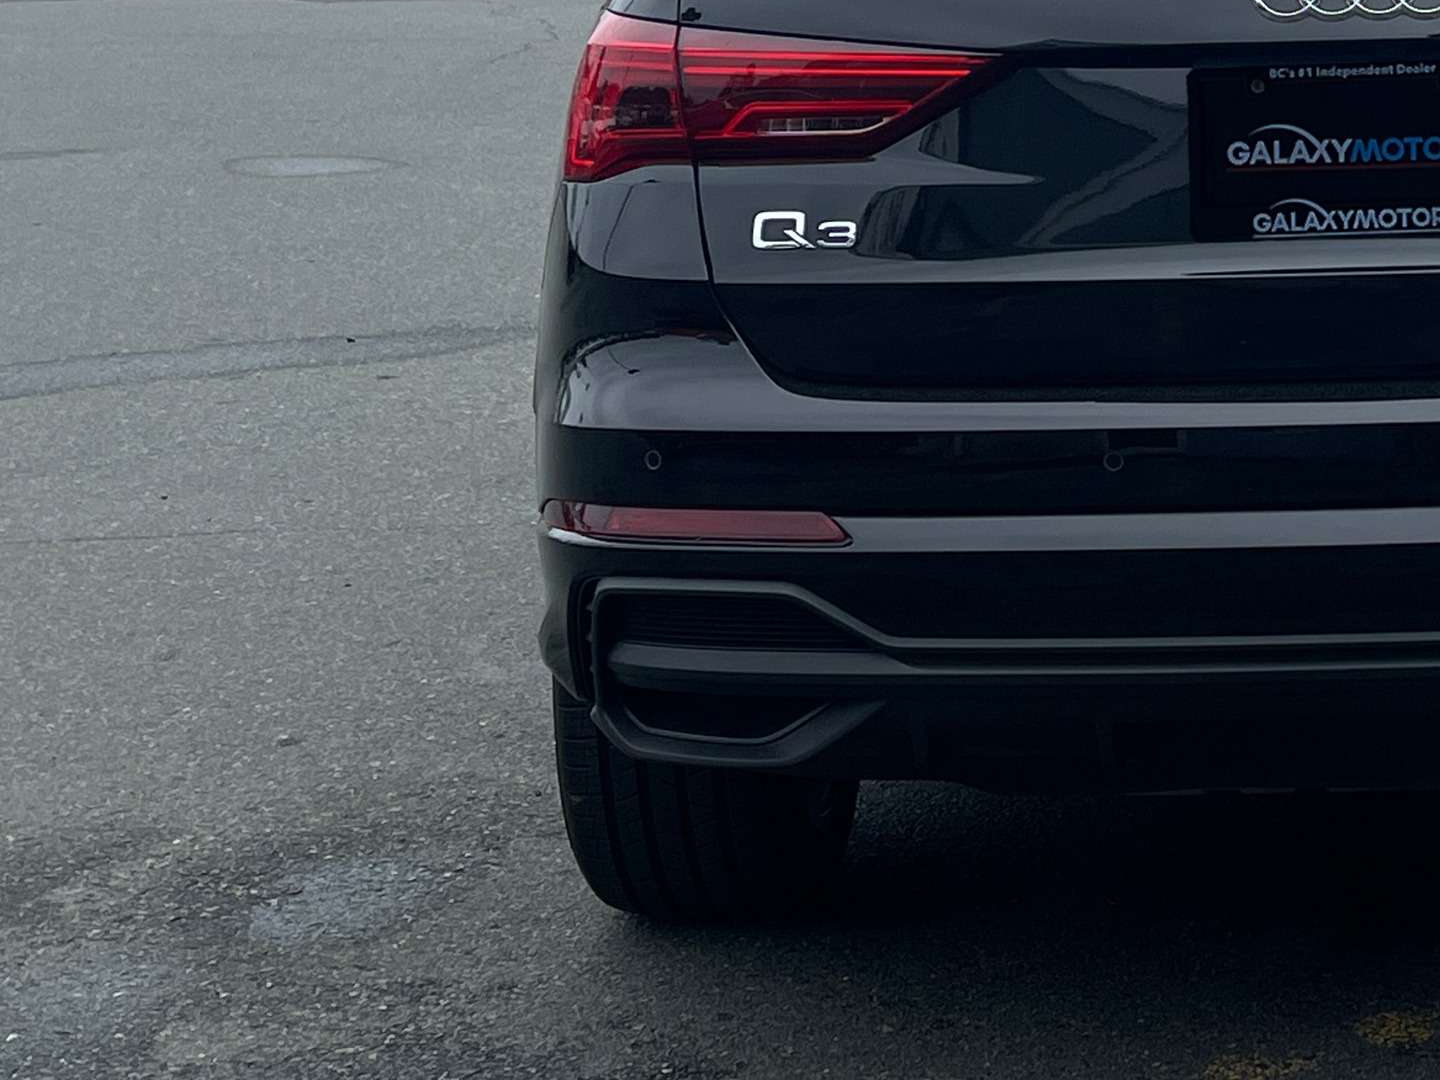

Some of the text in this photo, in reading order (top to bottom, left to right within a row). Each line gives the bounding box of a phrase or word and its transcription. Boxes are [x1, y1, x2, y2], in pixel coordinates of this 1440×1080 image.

[1316, 64, 1394, 79] Independent
[1396, 62, 1437, 75] Dealer
[752, 211, 857, 249] Q3
